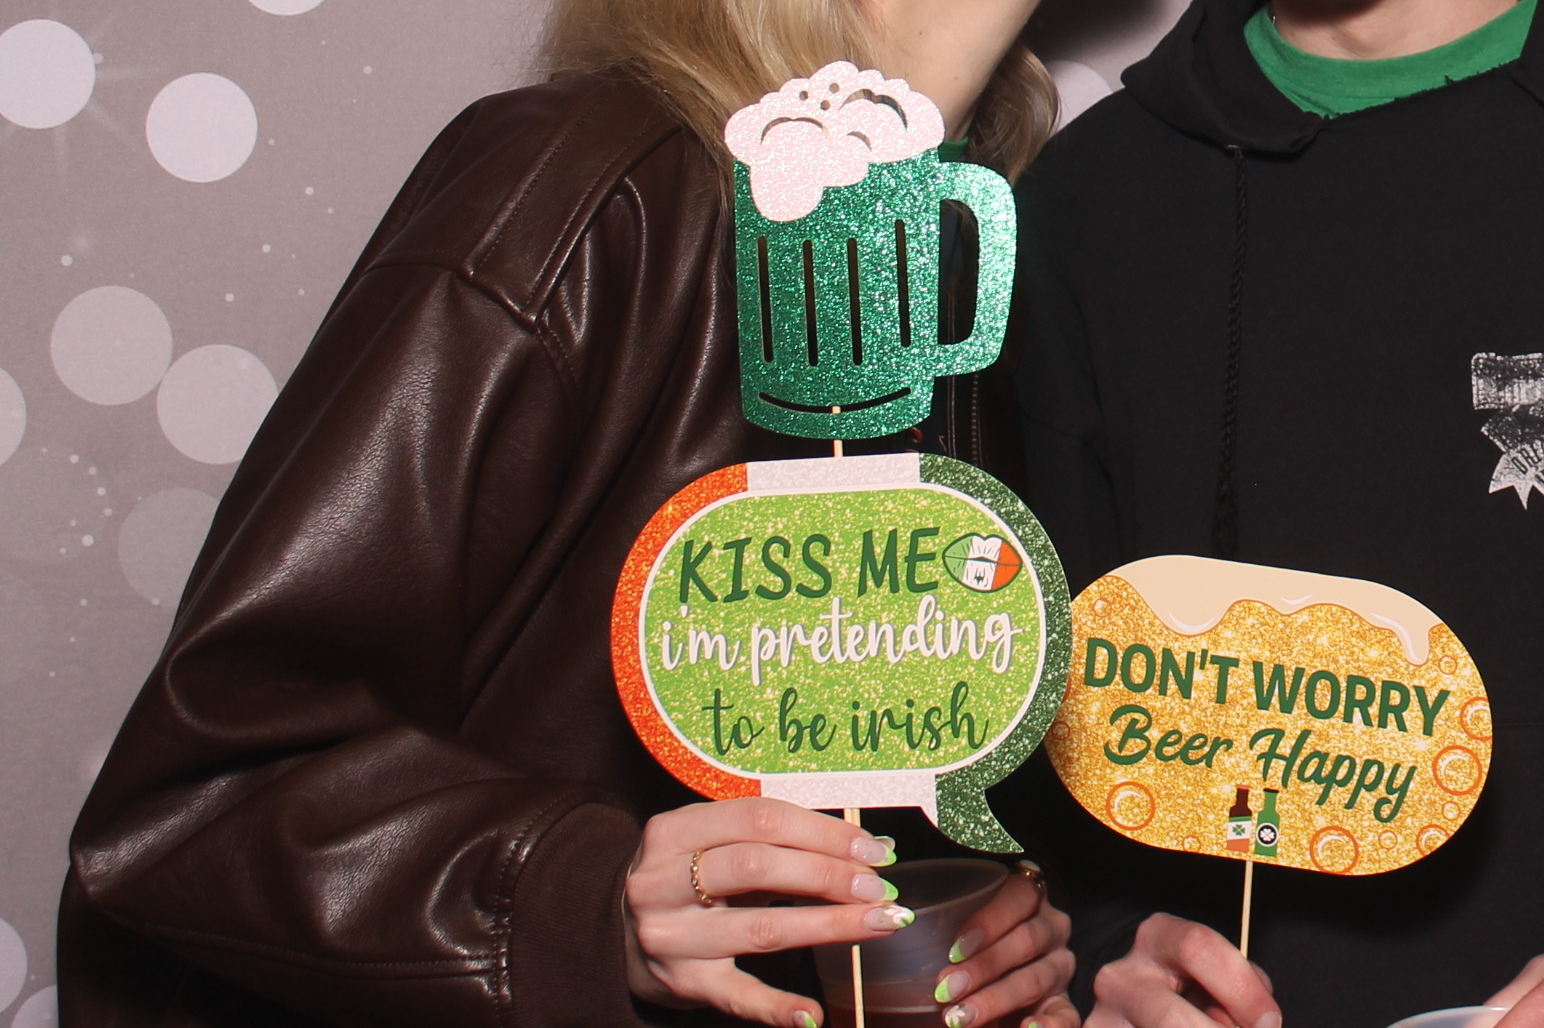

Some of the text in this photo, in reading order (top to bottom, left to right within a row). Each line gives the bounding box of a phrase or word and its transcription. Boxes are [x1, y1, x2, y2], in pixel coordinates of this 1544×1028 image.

[679, 526, 940, 604] KISS ME
[661, 594, 1027, 687] i'm pretending
[1083, 636, 1451, 737] DON'T WORRY
[702, 681, 990, 757] to be irish
[1103, 703, 1418, 824] Beer Happy
